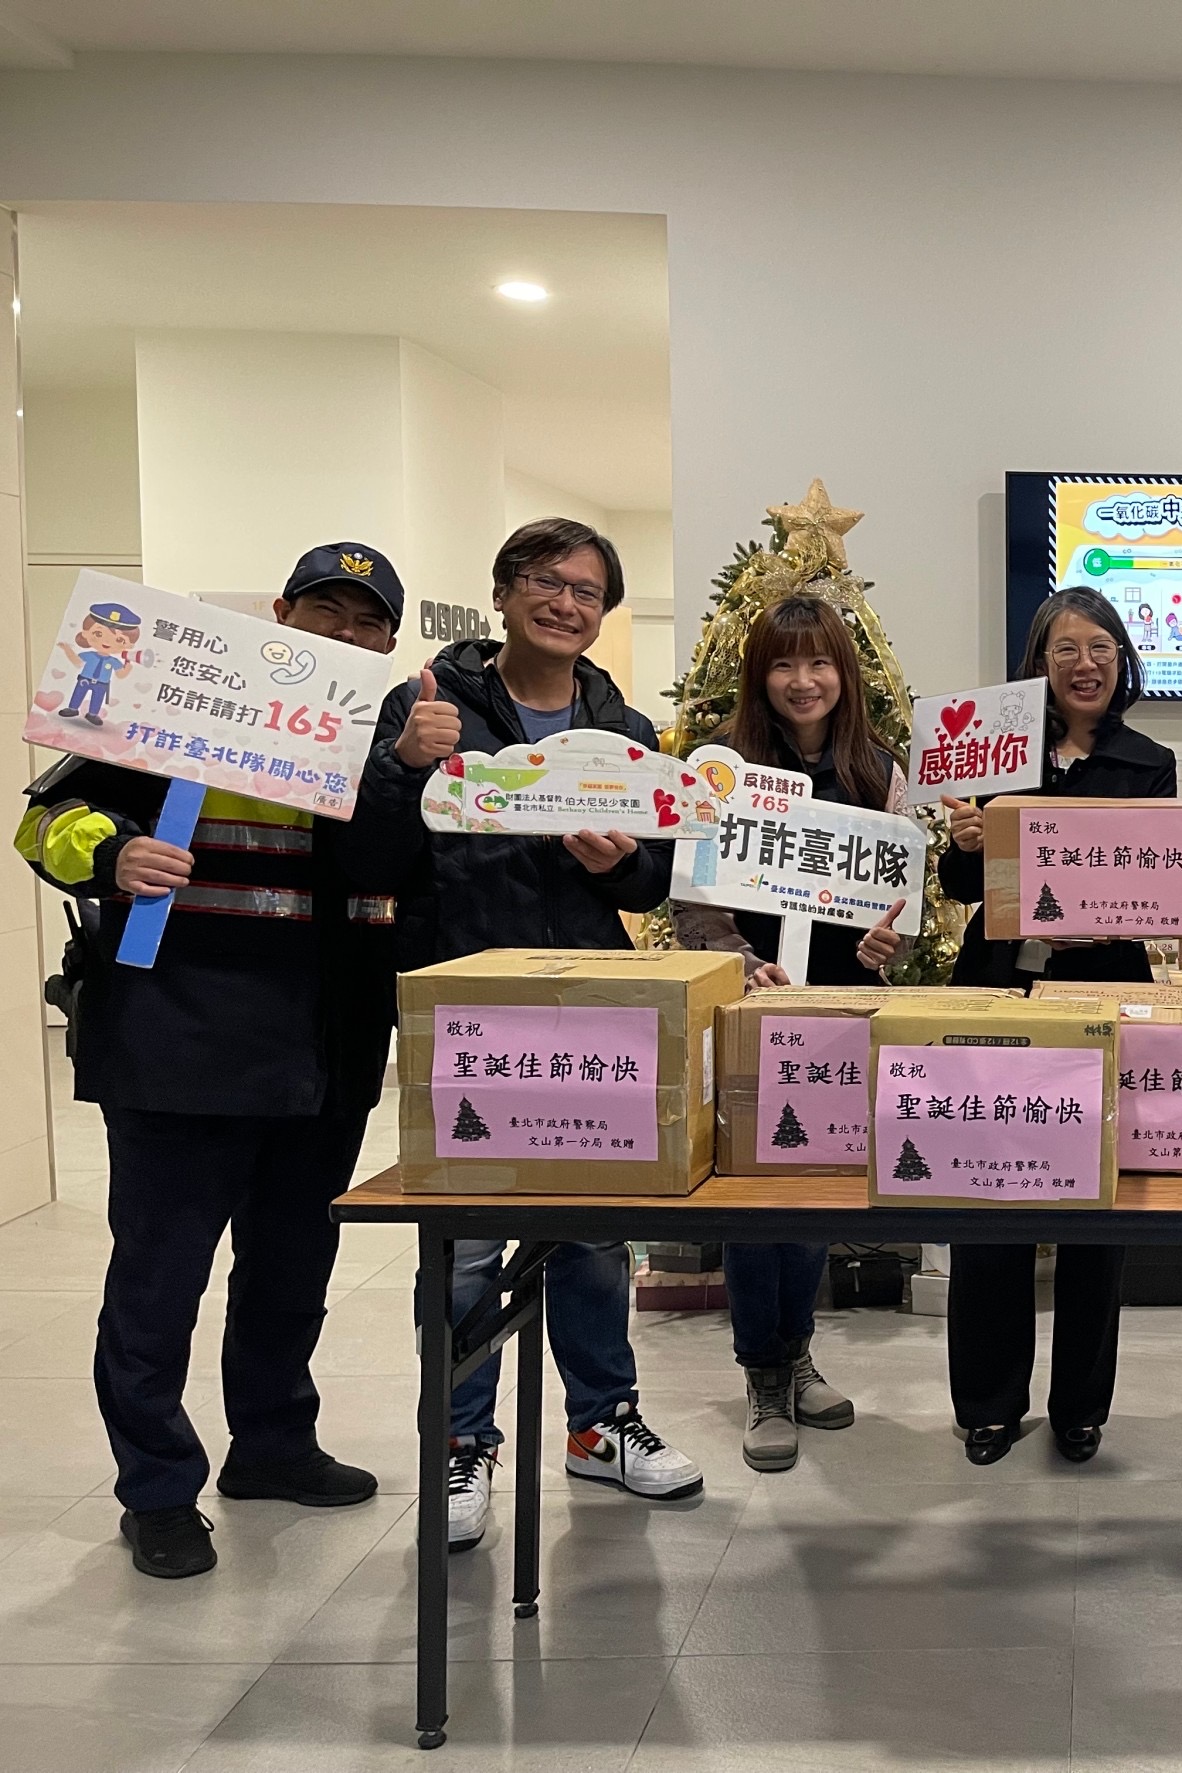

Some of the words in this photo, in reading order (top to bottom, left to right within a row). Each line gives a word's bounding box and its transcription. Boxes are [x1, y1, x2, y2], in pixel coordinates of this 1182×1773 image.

[152, 619, 228, 655] 警用心
[170, 655, 247, 691] 您安心
[126, 721, 349, 795] 打詐臺北隊關心您
[918, 732, 1030, 787] 感謝你
[743, 772, 806, 797] 反詐請打
[315, 795, 341, 808] 廣告
[505, 793, 563, 803] 財團法人基督教
[564, 797, 641, 808] 伯大尼兒少家園
[750, 793, 790, 814] 165
[514, 804, 554, 813] 臺北市私立
[557, 806, 586, 814] Bethany
[588, 807, 625, 815] Children's
[1028, 820, 1059, 835] 敬祝
[719, 813, 910, 888] 打詐臺北隊
[770, 884, 811, 899] 臺北市政府
[780, 899, 855, 921] 守護您的財產安全
[1079, 899, 1160, 912] 臺北市政府警察局
[1094, 914, 1154, 927] 文山第一分局
[1160, 914, 1180, 927] 敬贈
[446, 1020, 483, 1038] 敬祝
[769, 1031, 805, 1047] 敬祝
[453, 1051, 640, 1083] 聖誕佳節愉快
[777, 1060, 863, 1086] 聖誕佳
[889, 1062, 927, 1079] 敬祝
[896, 1093, 1084, 1125] 聖誕佳節愉快
[508, 1116, 608, 1132] 臺北市政府警察局
[528, 1135, 603, 1149] 文山第一分局
[610, 1135, 635, 1150] 敬贈
[844, 1142, 867, 1153] 文山
[950, 1158, 1051, 1172] 臺北市政府警察局
[970, 1176, 1044, 1189] 文山第一分局
[1052, 1176, 1076, 1190] 敬贈
